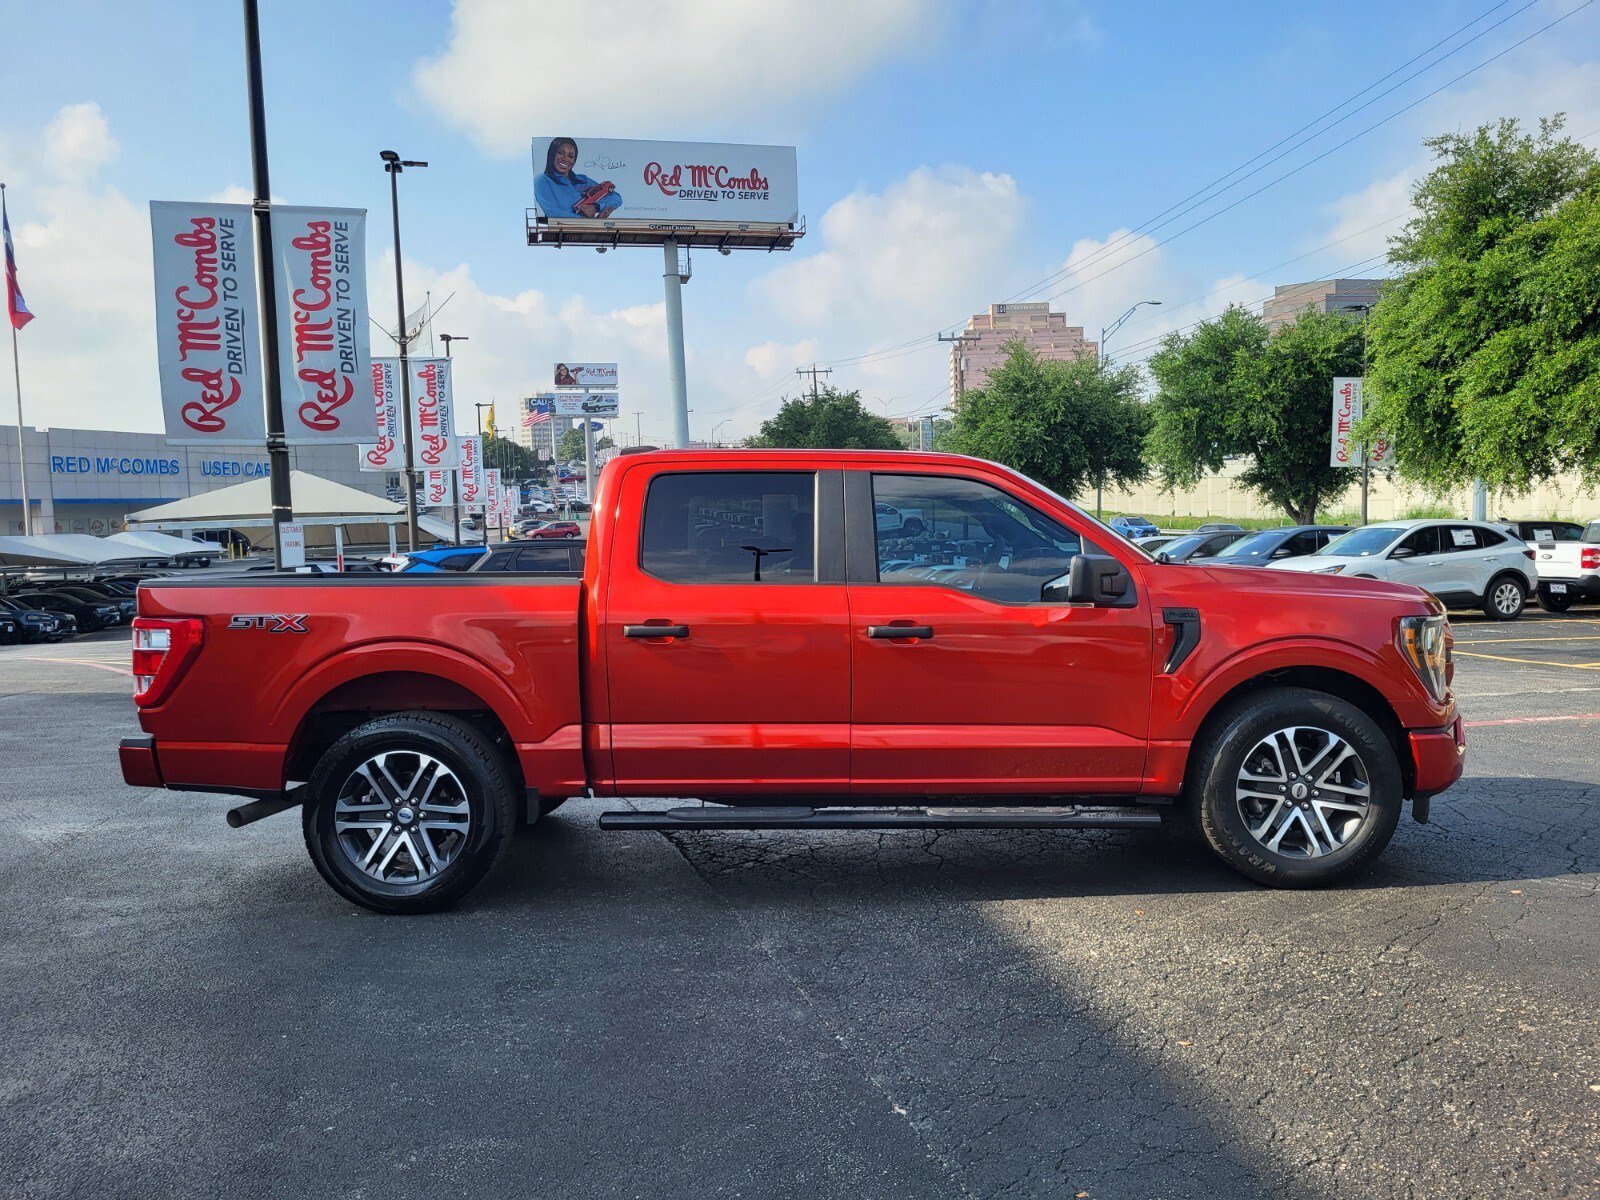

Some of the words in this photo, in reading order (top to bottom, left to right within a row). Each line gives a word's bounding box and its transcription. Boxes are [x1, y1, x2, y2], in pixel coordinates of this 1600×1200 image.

[643, 162, 682, 196] Red
[685, 165, 769, 190] McCombs
[678, 189, 718, 199] DRIVEN
[720, 191, 735, 199] TO
[738, 191, 769, 200] SERVE
[219, 217, 237, 273] SERVE
[334, 221, 349, 275] SERVE
[174, 217, 221, 362] McCombs
[222, 276, 238, 302] TO
[292, 220, 334, 363] McCombs
[336, 278, 351, 302] TO
[223, 306, 244, 376] DRIVEN
[337, 307, 355, 375] DRIVEN
[384, 363, 393, 390] SERVE
[437, 364, 445, 390] SERVE
[181, 367, 242, 433] Red
[298, 367, 354, 432] Red
[386, 391, 394, 402] TO
[417, 364, 439, 432] McCombs
[438, 391, 446, 402] TO
[387, 405, 397, 438] DRIVEN
[439, 405, 449, 437] DRIVEN
[420, 434, 448, 465] Red
[51, 456, 91, 474] RED
[202, 461, 241, 477] USED
[243, 462, 271, 477] CAR
[429, 483, 447, 503] Red
[462, 483, 479, 502] Red
[281, 526, 303, 534] CUSTOMER
[284, 540, 302, 548] PARKING
[226, 614, 311, 634] STX
